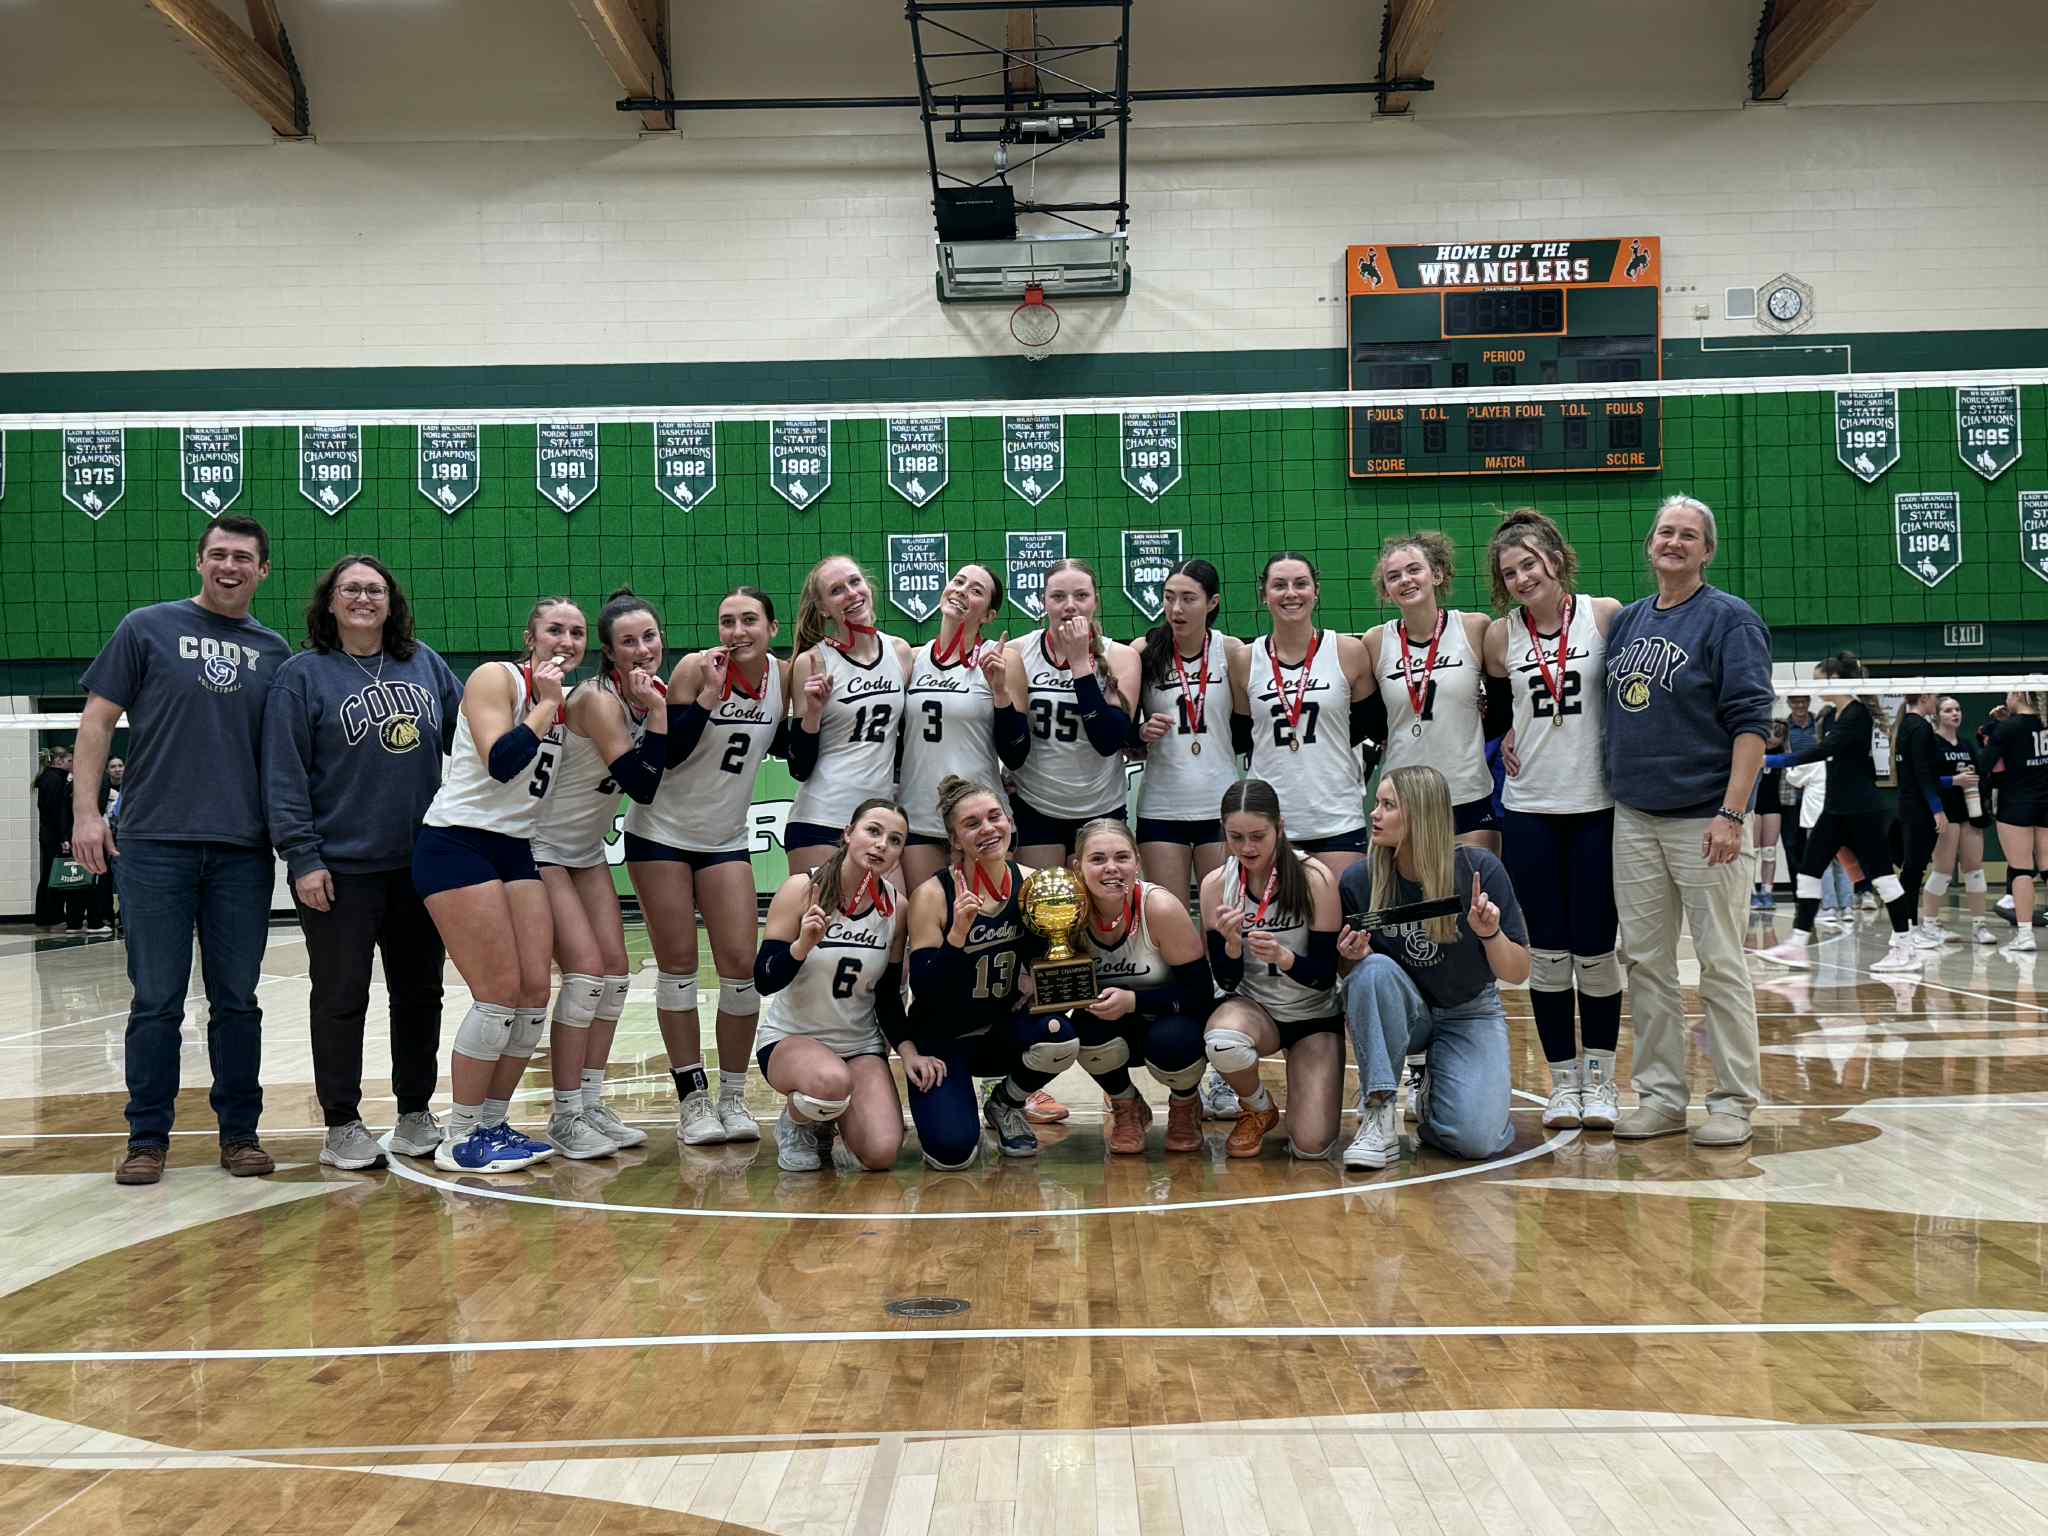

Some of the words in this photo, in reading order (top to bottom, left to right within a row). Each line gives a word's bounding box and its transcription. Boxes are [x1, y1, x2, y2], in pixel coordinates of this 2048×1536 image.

[1436, 245, 1492, 260] HOME
[1498, 244, 1521, 259] OF
[1531, 243, 1569, 258] THE
[1418, 258, 1589, 286] WRANGLERS
[1483, 350, 1525, 363] PERIOD
[1367, 409, 1404, 421] FOULS
[1419, 408, 1450, 420] T.O.L.
[1467, 405, 1509, 418] PLAYER
[1516, 404, 1545, 417] FOUL
[1560, 404, 1591, 416] T.O.L.
[1606, 402, 1644, 415] FOULS
[1848, 408, 1884, 416] STATE
[1969, 405, 2006, 414] STATE
[1840, 418, 1894, 430] CHAMPIONS
[1962, 415, 2015, 427] CHAMPIONS
[784, 435, 817, 444] STATE
[900, 433, 935, 442] STATE
[1016, 431, 1050, 440] STATE
[1132, 428, 1167, 437] STATE
[1846, 431, 1887, 448] 1983
[1968, 428, 2010, 445] 1985
[194, 443, 230, 451] STATE
[313, 441, 347, 449] STATE
[432, 440, 466, 448] STATE
[550, 439, 584, 448] STATE
[667, 437, 702, 446] STATE
[1008, 441, 1059, 453] CHAMPIONS
[1126, 438, 1176, 450] CHAMPIONS
[77, 444, 111, 454] STATE
[423, 450, 475, 462] CHAMPIONS
[541, 449, 593, 460] CHAMPIONS
[659, 447, 711, 459] CHAMPIONS
[775, 446, 826, 457] CHAMPIONS
[892, 443, 943, 455] CHAMPIONS
[68, 454, 120, 467] CHAMPIONS
[186, 453, 238, 465] CHAMPIONS
[304, 451, 357, 463] CHAMPIONS
[1014, 455, 1053, 471] 1982
[1131, 451, 1170, 467] 1983
[1485, 456, 1525, 468] MATCH
[1606, 453, 1645, 465] SCORE
[550, 462, 586, 479] 1981
[666, 461, 705, 475] 1982
[781, 459, 821, 474] 1982
[899, 456, 938, 473] 1982
[1368, 458, 1404, 471] SCORE
[74, 468, 114, 485] 1975
[193, 466, 233, 482] 1980
[311, 465, 351, 481] 1980
[432, 464, 467, 480] 1981
[1910, 511, 1946, 520] STATE
[1901, 521, 1955, 534] CHAMPIONS
[1909, 534, 1950, 552] 1984
[2031, 533, 2048, 550] 19
[901, 553, 936, 561] STATE
[1019, 550, 1053, 559] STATE
[893, 562, 944, 575] CHAMPIONS
[1135, 568, 1169, 582] 2009
[900, 575, 939, 591] 2015
[1017, 573, 1044, 589] 201
[1952, 625, 1977, 643] EXIT
[179, 636, 259, 671] CODY
[848, 676, 893, 693] Cody
[917, 674, 960, 689] Cody
[1033, 672, 1075, 688] Cod
[1529, 670, 1581, 718] 22
[340, 681, 437, 745] CODY
[720, 703, 765, 722] Cody
[1176, 694, 1207, 734] 11
[848, 704, 892, 743] 12
[922, 700, 942, 743] 3
[1030, 699, 1078, 742] 35
[1271, 702, 1319, 746] 27
[720, 733, 751, 774] 2
[529, 752, 554, 798] 5
[1242, 913, 1293, 929] Cody
[826, 924, 877, 946] Cody
[970, 921, 1018, 943] Cody
[832, 957, 863, 999] 6
[972, 950, 1016, 999] 13
